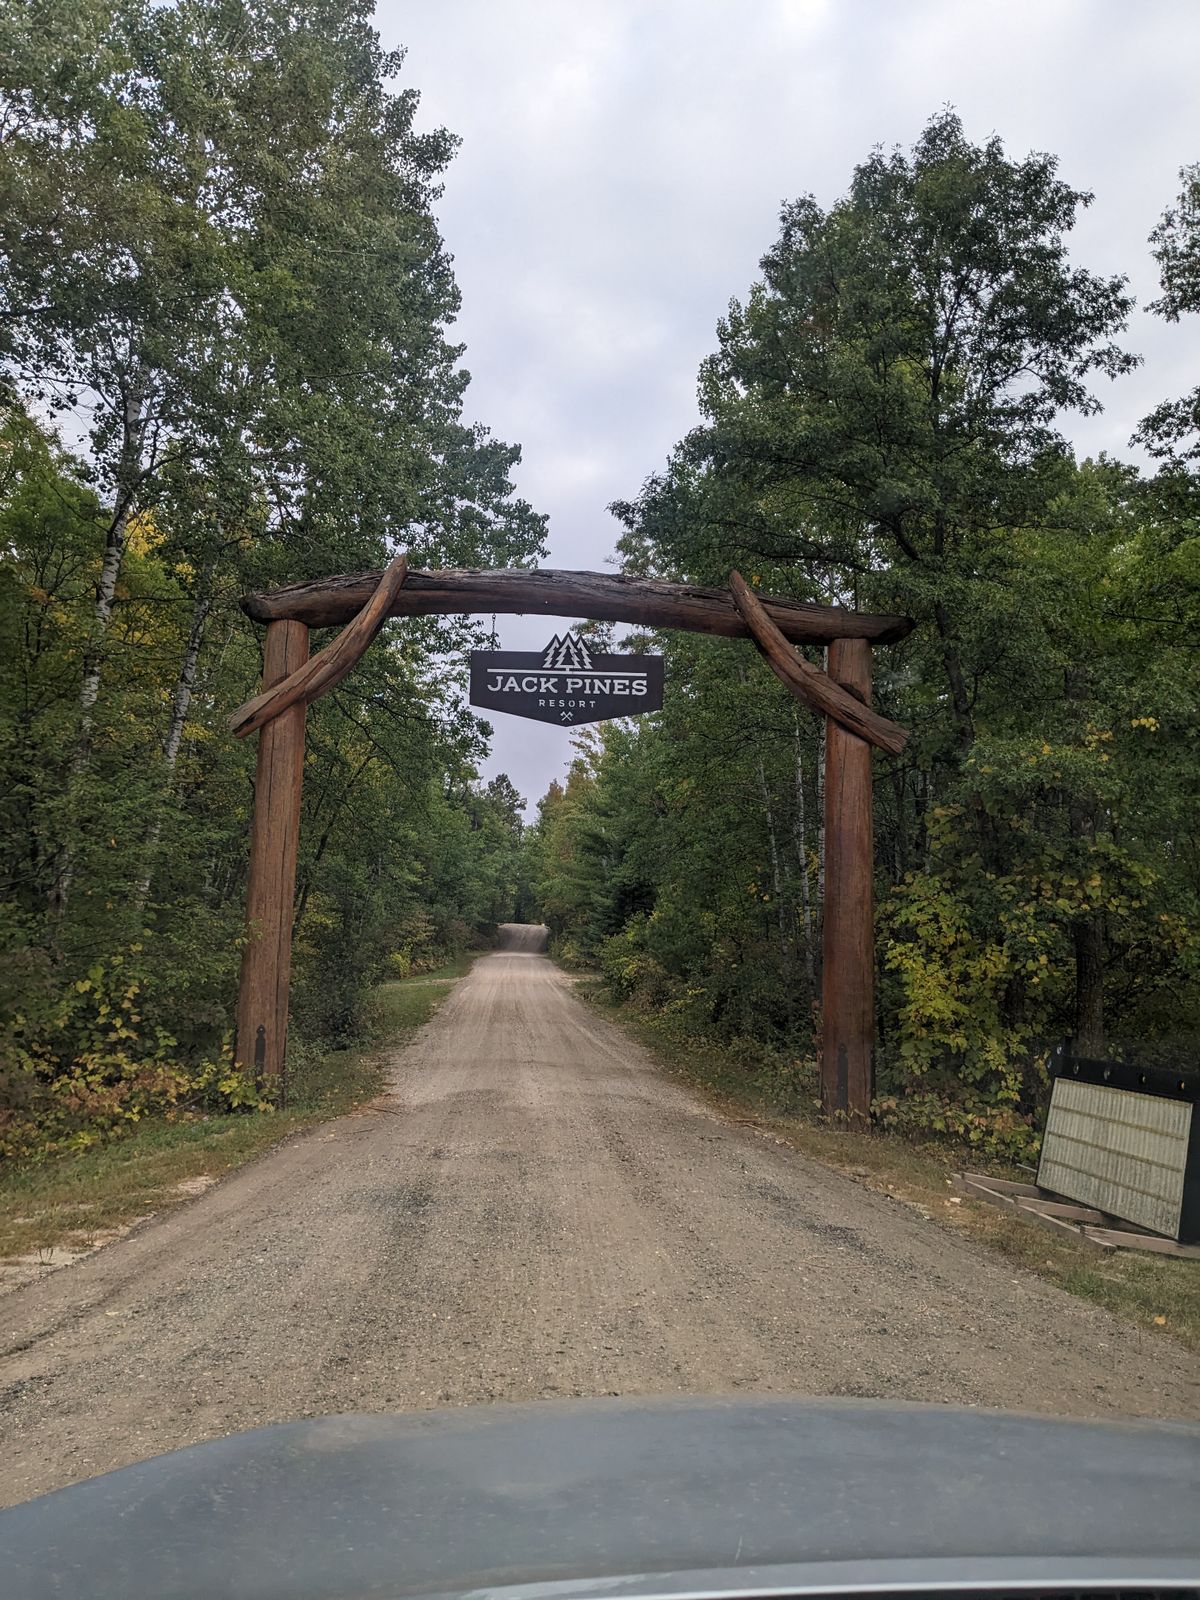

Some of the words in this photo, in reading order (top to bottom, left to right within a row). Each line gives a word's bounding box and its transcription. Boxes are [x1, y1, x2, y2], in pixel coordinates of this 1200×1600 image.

[487, 675, 559, 694] JACK
[565, 678, 648, 696] PINES
[538, 699, 597, 708] RESORT
